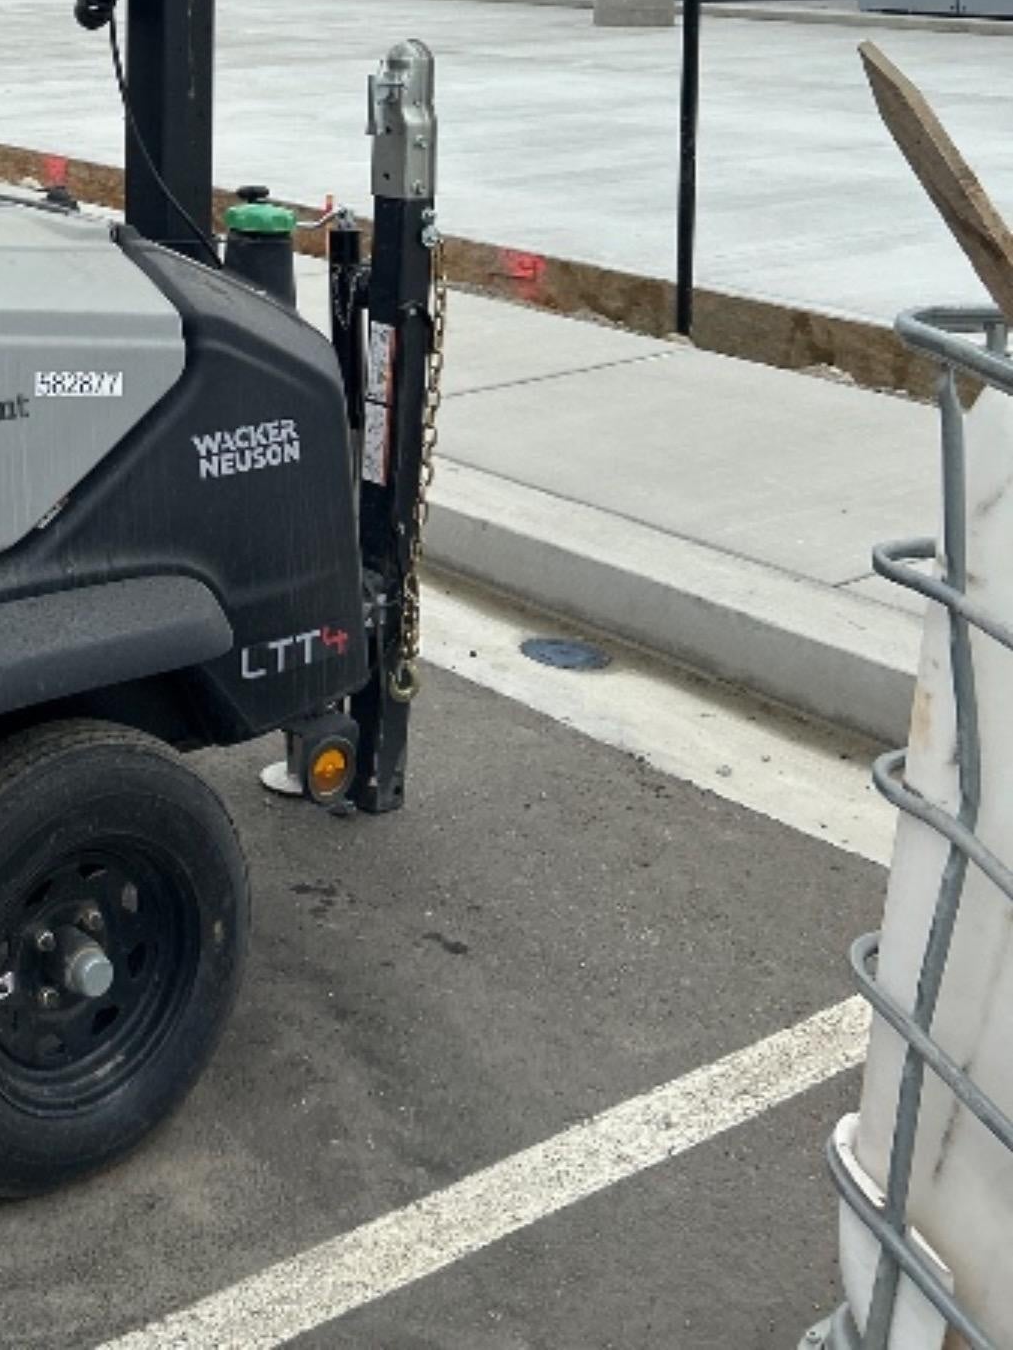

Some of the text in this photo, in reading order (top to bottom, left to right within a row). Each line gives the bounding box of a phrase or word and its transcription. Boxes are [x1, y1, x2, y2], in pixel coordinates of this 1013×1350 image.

[38, 370, 119, 395] 582877
[191, 419, 300, 457] WACKER
[198, 440, 300, 479] NEUSON
[241, 626, 348, 679] LTT4
